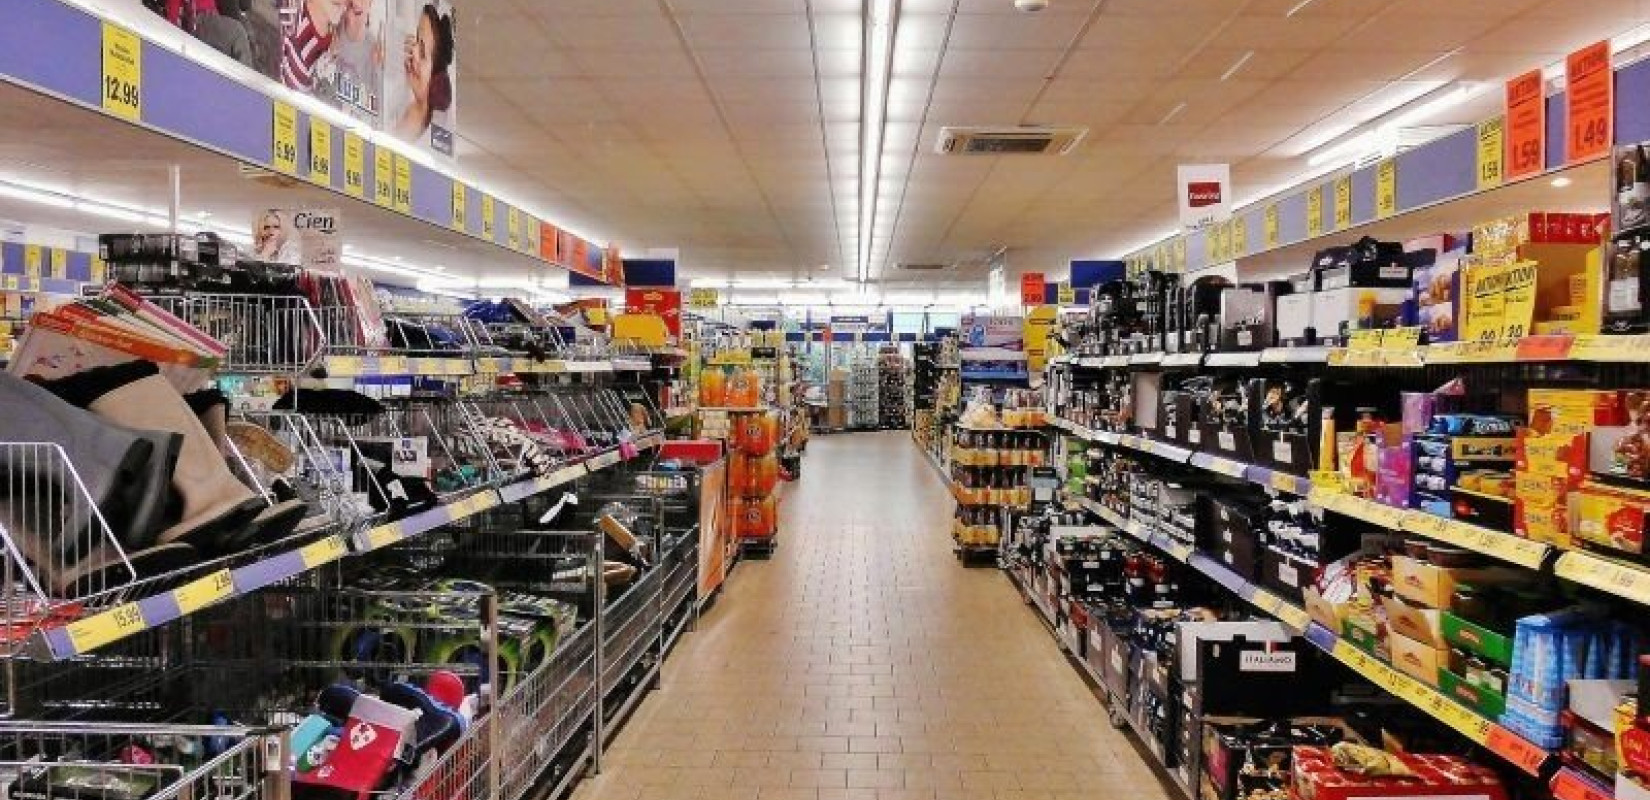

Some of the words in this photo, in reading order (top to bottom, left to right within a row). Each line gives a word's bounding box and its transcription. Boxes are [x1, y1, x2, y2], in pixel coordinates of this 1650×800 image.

[106, 74, 139, 108] 12.99
[1575, 117, 1608, 153] 1.49
[1513, 139, 1540, 171] 1.59
[295, 213, 333, 228] Cien
